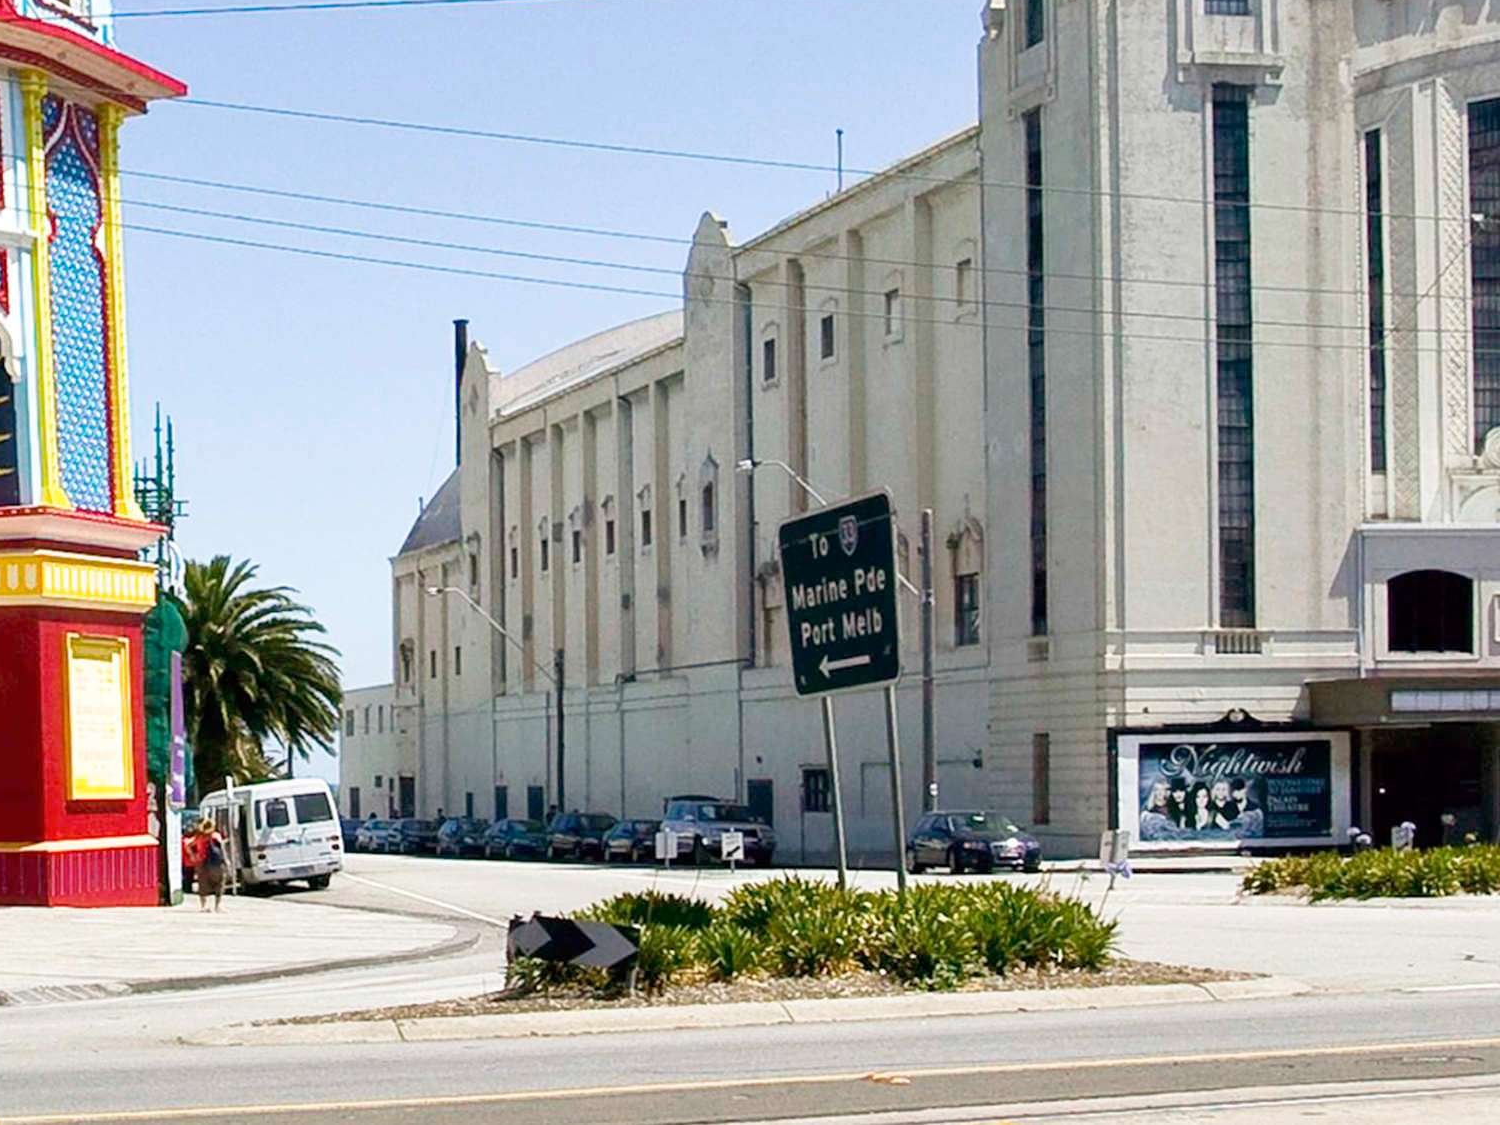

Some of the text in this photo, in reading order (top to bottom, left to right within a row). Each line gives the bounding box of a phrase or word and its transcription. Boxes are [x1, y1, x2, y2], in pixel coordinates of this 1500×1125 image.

[808, 533, 829, 560] To
[792, 565, 886, 611] Marine Pde
[801, 606, 883, 648] Port Melb
[1159, 743, 1306, 784] Nightwish
